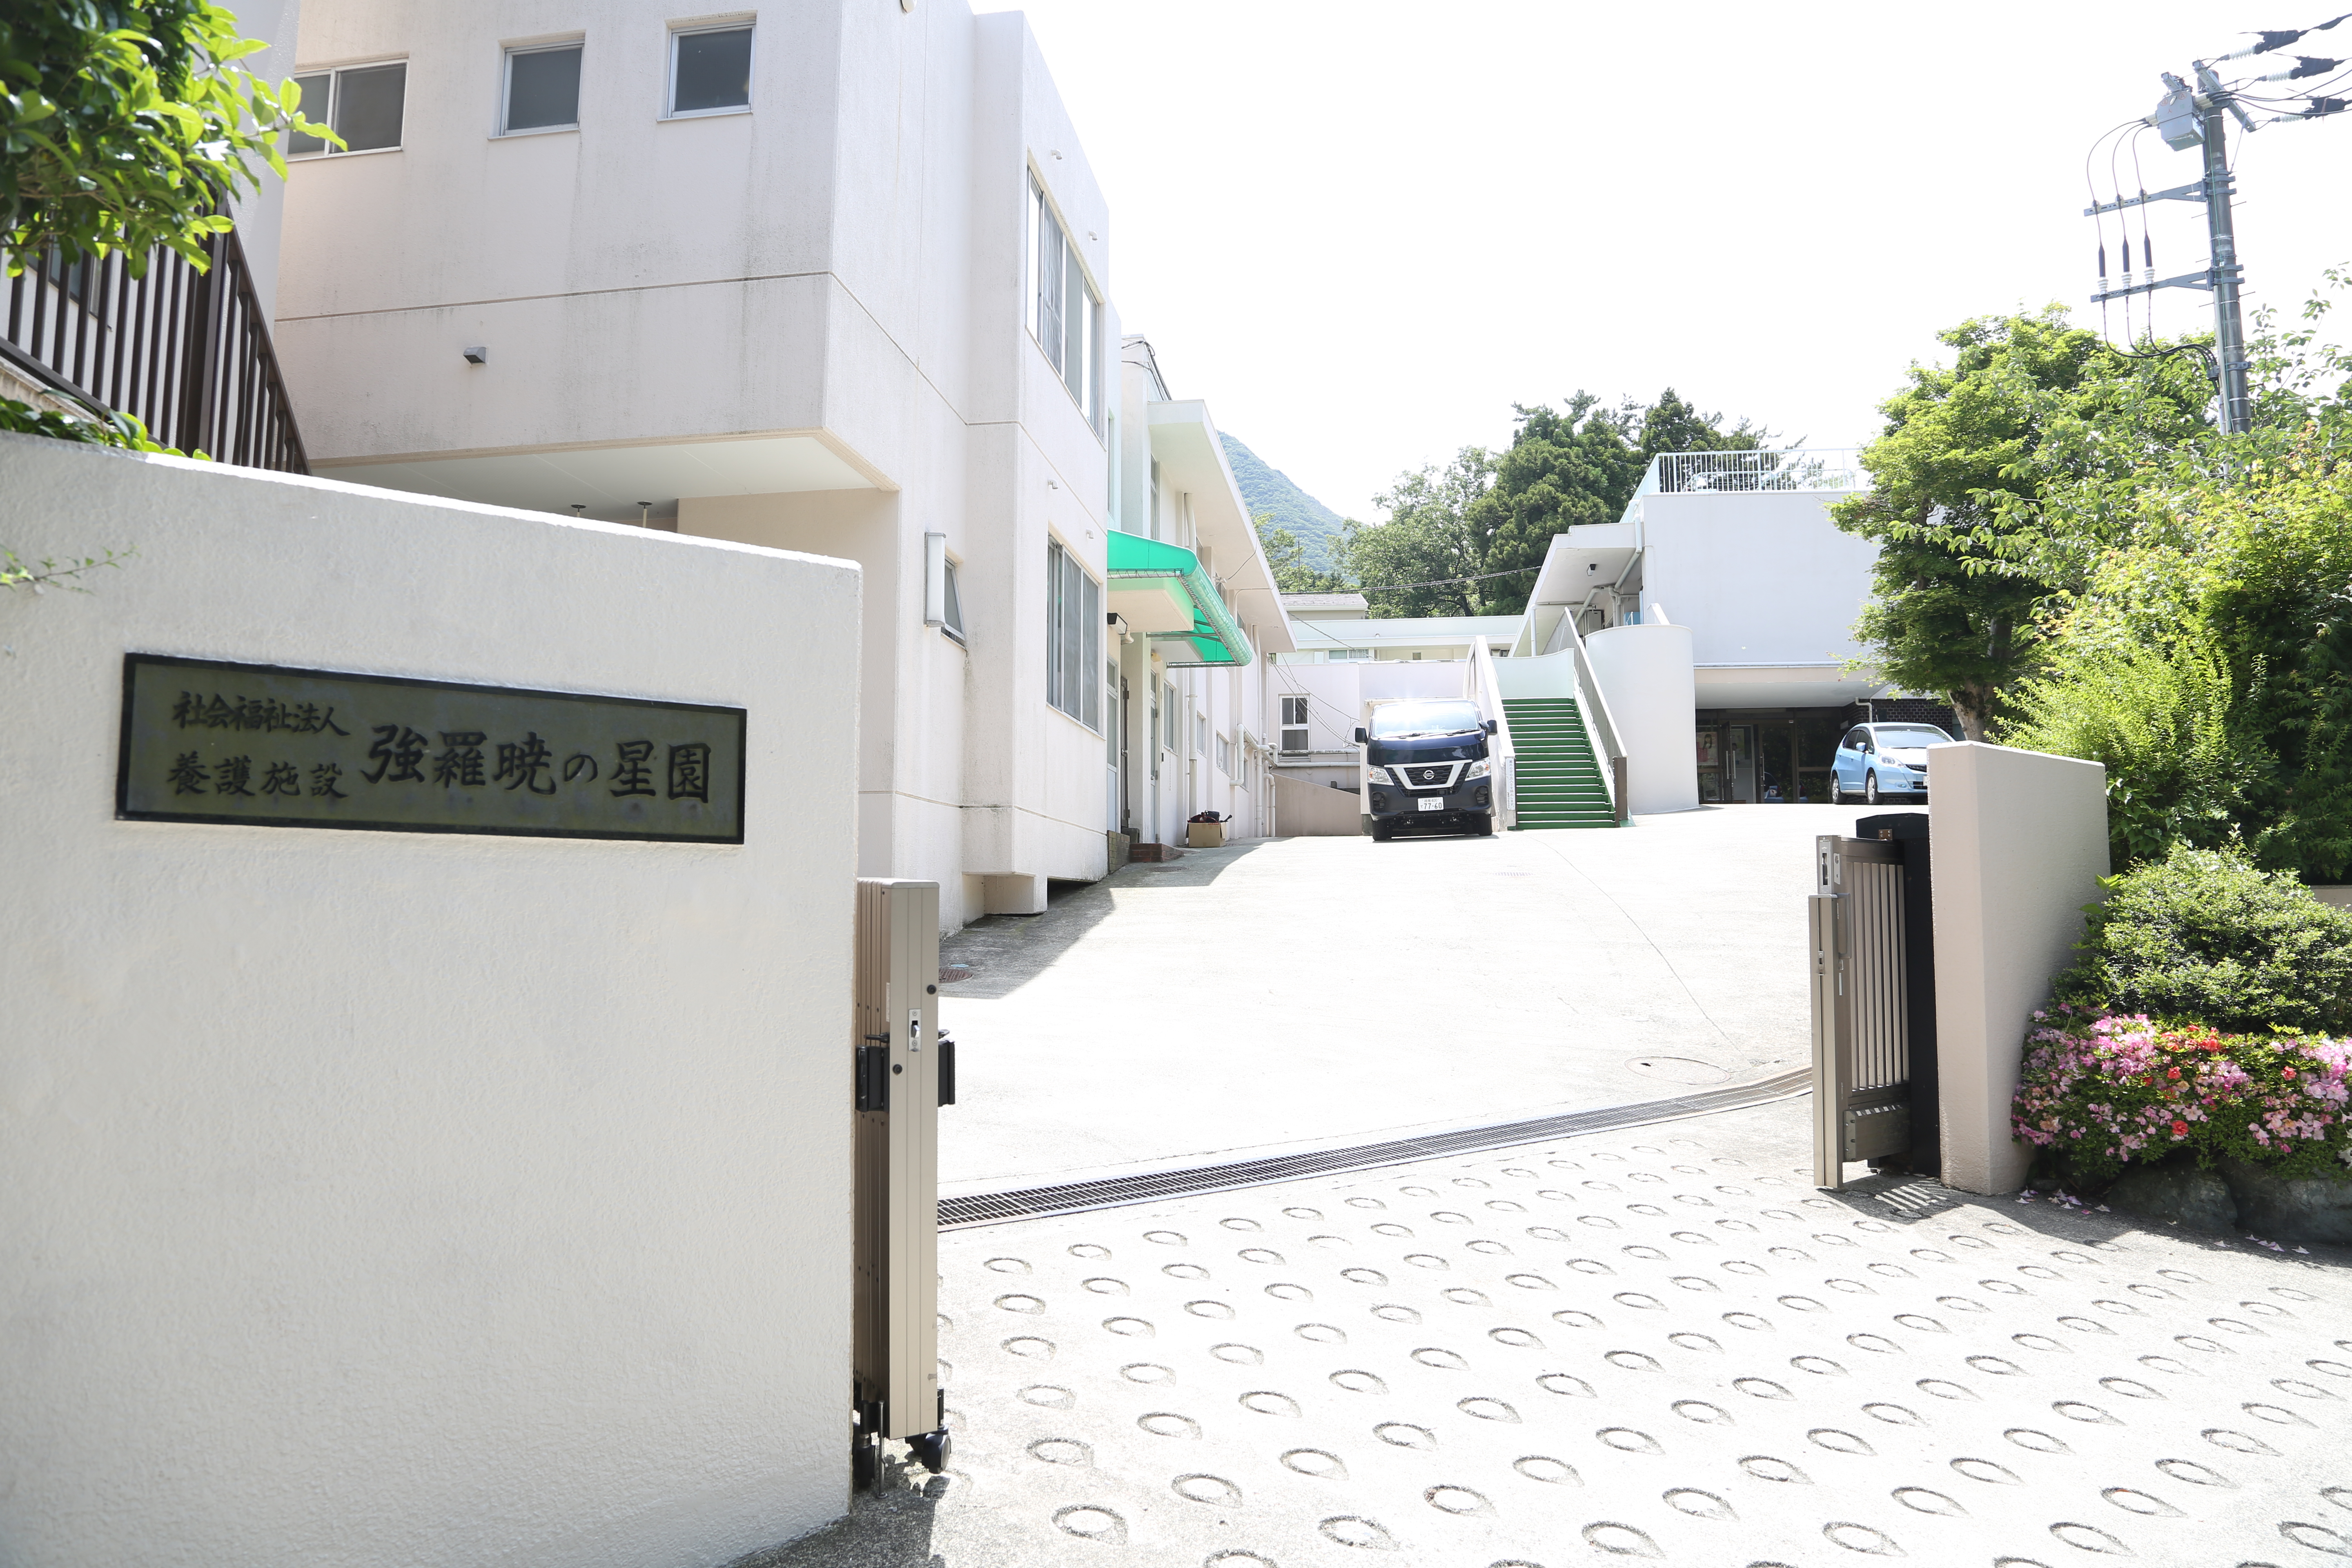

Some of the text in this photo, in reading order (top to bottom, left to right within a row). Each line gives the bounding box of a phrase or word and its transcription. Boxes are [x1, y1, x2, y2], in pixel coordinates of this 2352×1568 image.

[172, 690, 351, 736] 社会福祉法人
[167, 750, 349, 798] 養護施設
[361, 724, 712, 804] 強羅暁の星園
